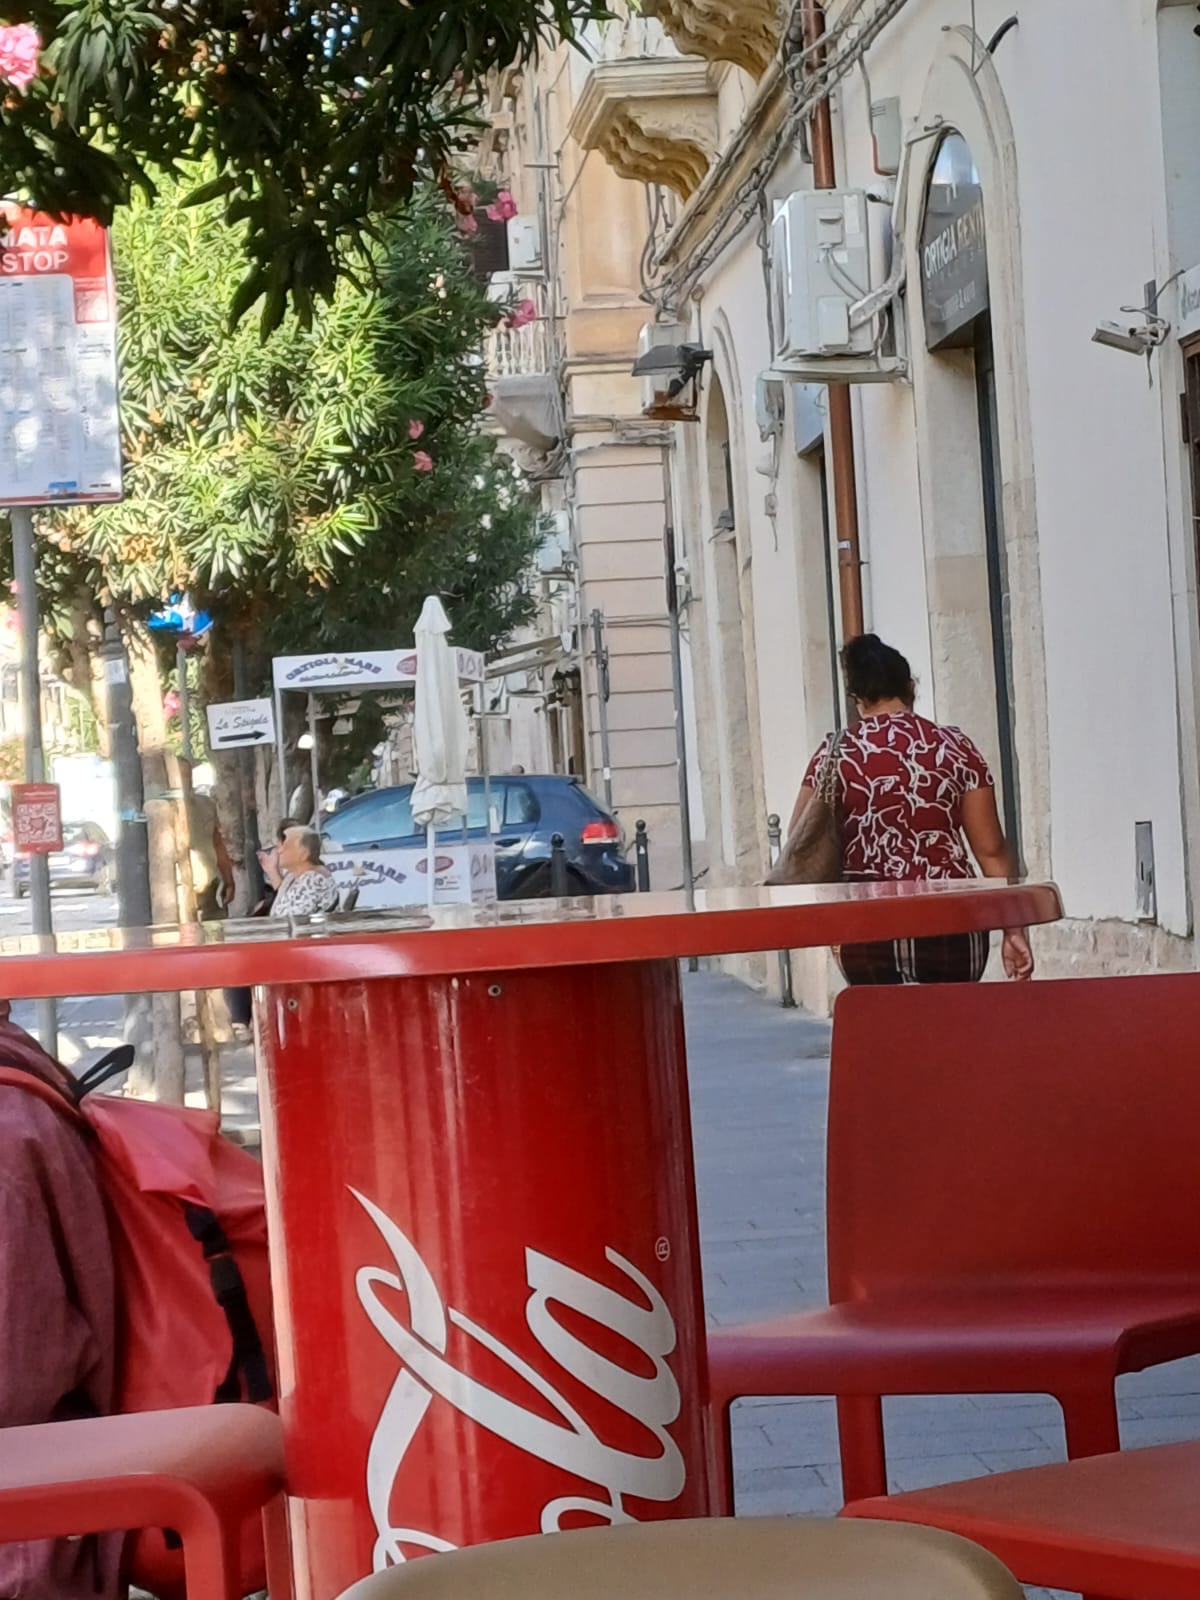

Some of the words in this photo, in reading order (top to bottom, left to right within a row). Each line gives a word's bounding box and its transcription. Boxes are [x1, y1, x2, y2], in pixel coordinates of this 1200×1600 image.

[1, 250, 68, 272] STOP
[923, 224, 957, 279] ORTIGIA
[344, 657, 382, 675] MARE
[362, 860, 407, 884] MARE
